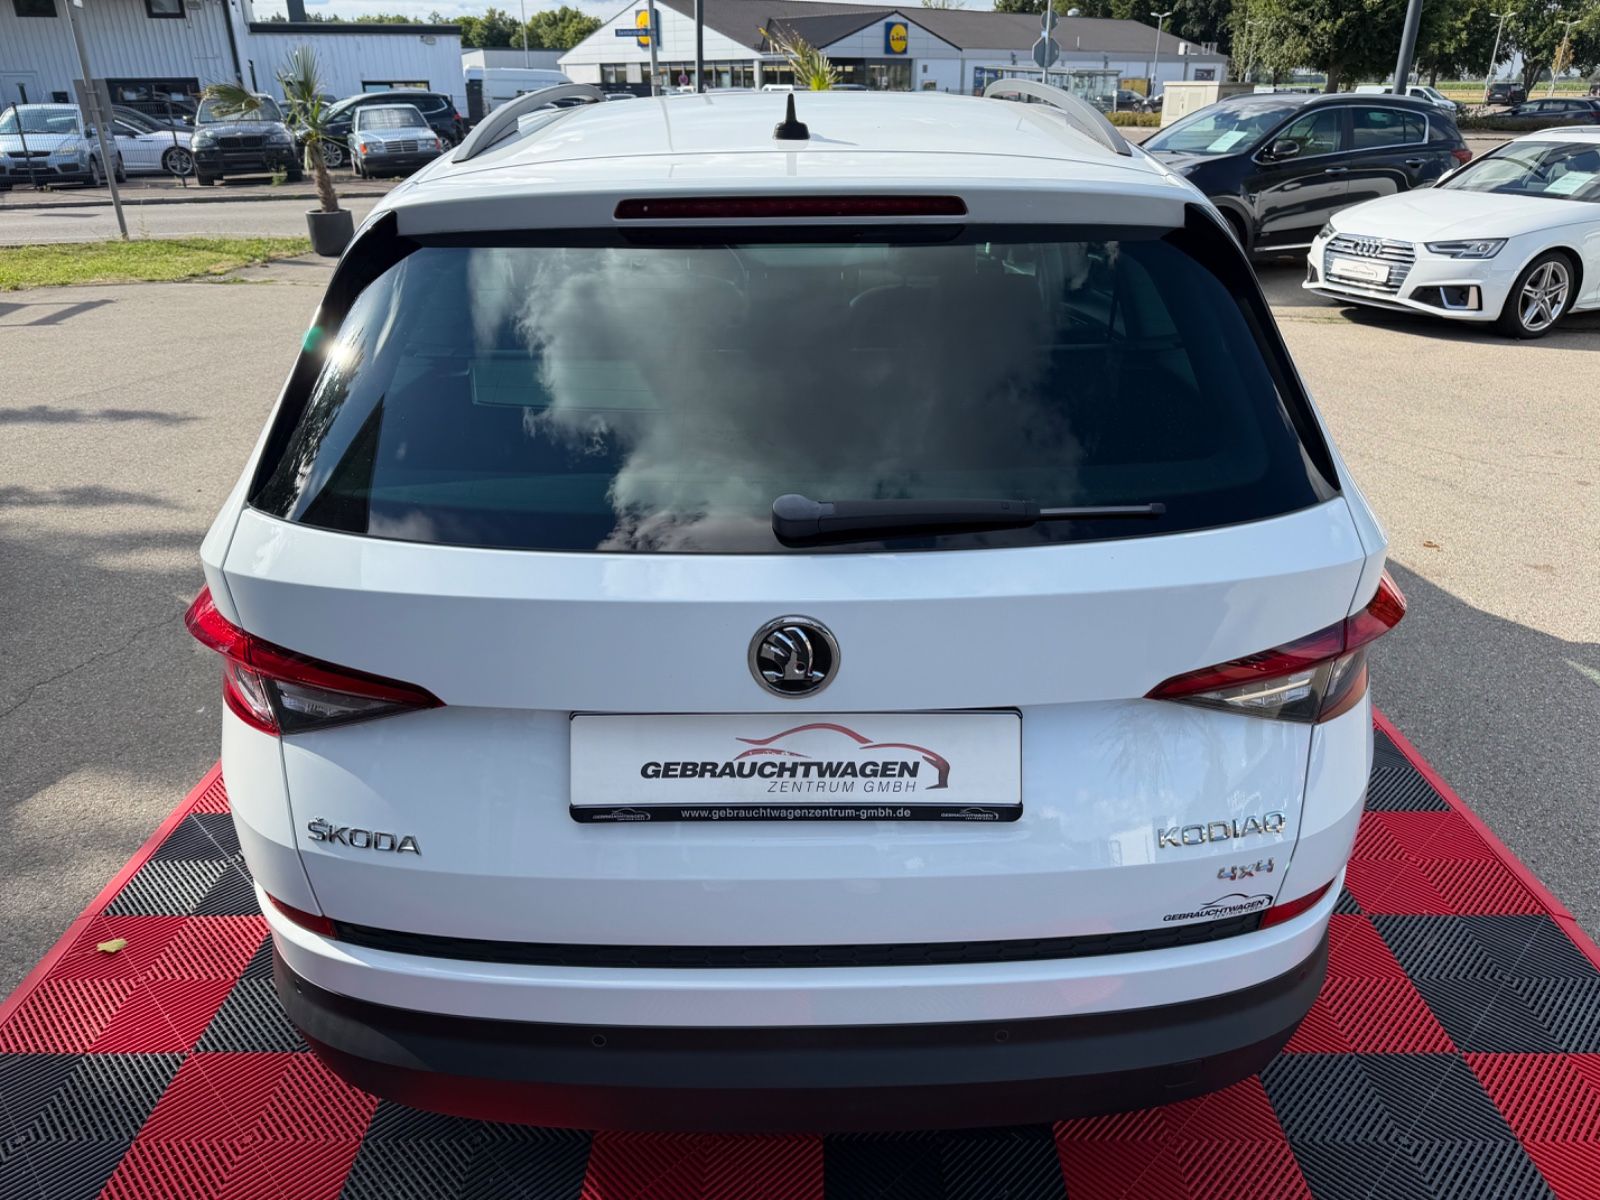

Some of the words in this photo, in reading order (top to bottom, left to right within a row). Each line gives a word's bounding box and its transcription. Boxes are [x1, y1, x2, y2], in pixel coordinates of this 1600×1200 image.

[640, 761, 920, 779] GEBRAUCHTWAGEN
[767, 780, 856, 792] ZENTRUM
[863, 780, 917, 792] GMBH
[680, 808, 912, 820] www.gebrauchtwagenzentrum-gmbh.de
[307, 817, 421, 856] ŠKODA
[1157, 811, 1286, 848] KODIAQ
[1163, 899, 1265, 922] GEBRAUCHTWAGEN
